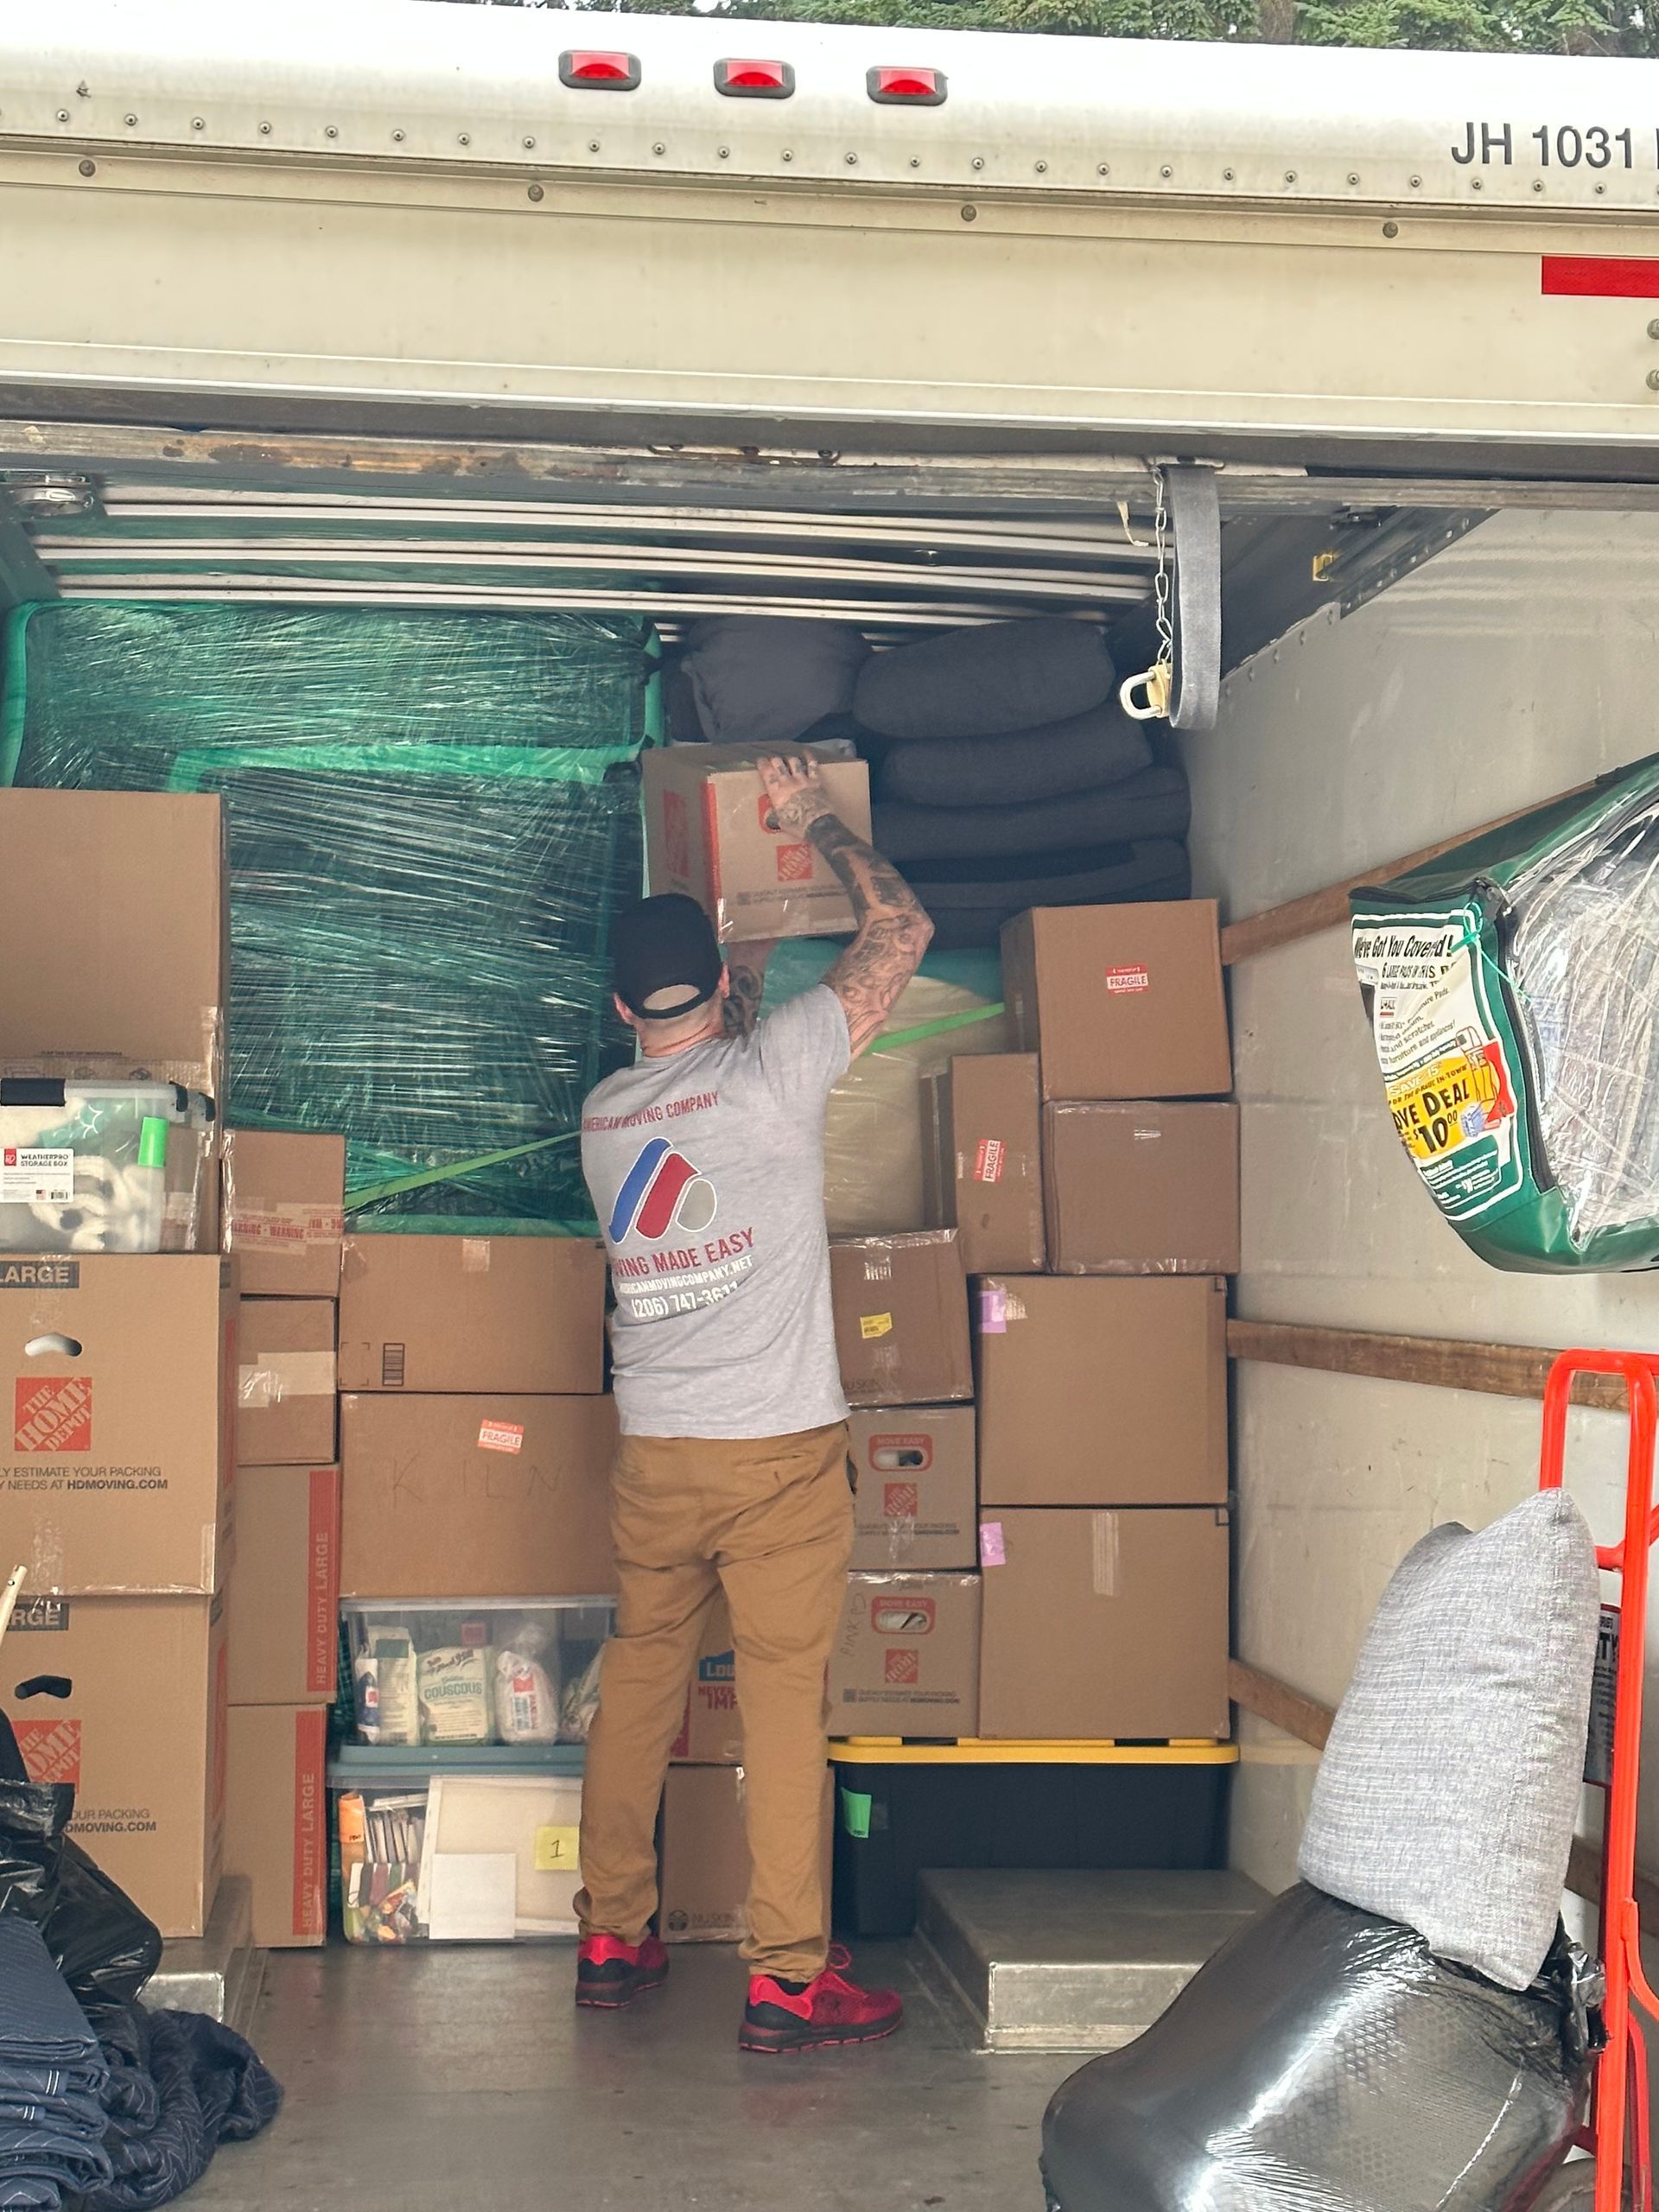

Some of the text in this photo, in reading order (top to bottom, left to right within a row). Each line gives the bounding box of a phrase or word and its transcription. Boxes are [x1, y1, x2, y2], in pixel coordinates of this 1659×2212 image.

[1451, 122, 1512, 165] JH
[1532, 125, 1632, 168] 1031
[1372, 935, 1388, 957] Got
[1387, 935, 1404, 957] You
[1109, 976, 1147, 987] FRAGILE
[621, 1104, 664, 1128] MOVING
[665, 1090, 719, 1118] COMPANY
[1392, 1078, 1469, 1130] OVE DEAL
[984, 1141, 999, 1179] FRAGILE
[613, 1226, 754, 1277] VING MADE EASY
[632, 1297, 670, 1318] (206)
[23, 1385, 54, 1414] THE
[16, 1377, 92, 1452] HOME
[44, 1405, 92, 1452] DEPOT
[482, 1431, 520, 1446] FRAGILE
[14, 1467, 70, 1477] ESTIMATE
[73, 1467, 106, 1477] YOUR
[110, 1467, 161, 1477] PACKING
[8, 1479, 168, 1491] NEEDS AT HDMOVING.COM
[315, 1532, 328, 1684] HEAVY DUTY LARGE
[423, 1681, 482, 1700] COUSCOUS
[99, 1808, 150, 1820] PACKING
[65, 1821, 156, 1833] DMOVING.COM
[302, 1772, 315, 1928] HEAVY DUTY LARGE
[550, 1839, 566, 1859] 1
